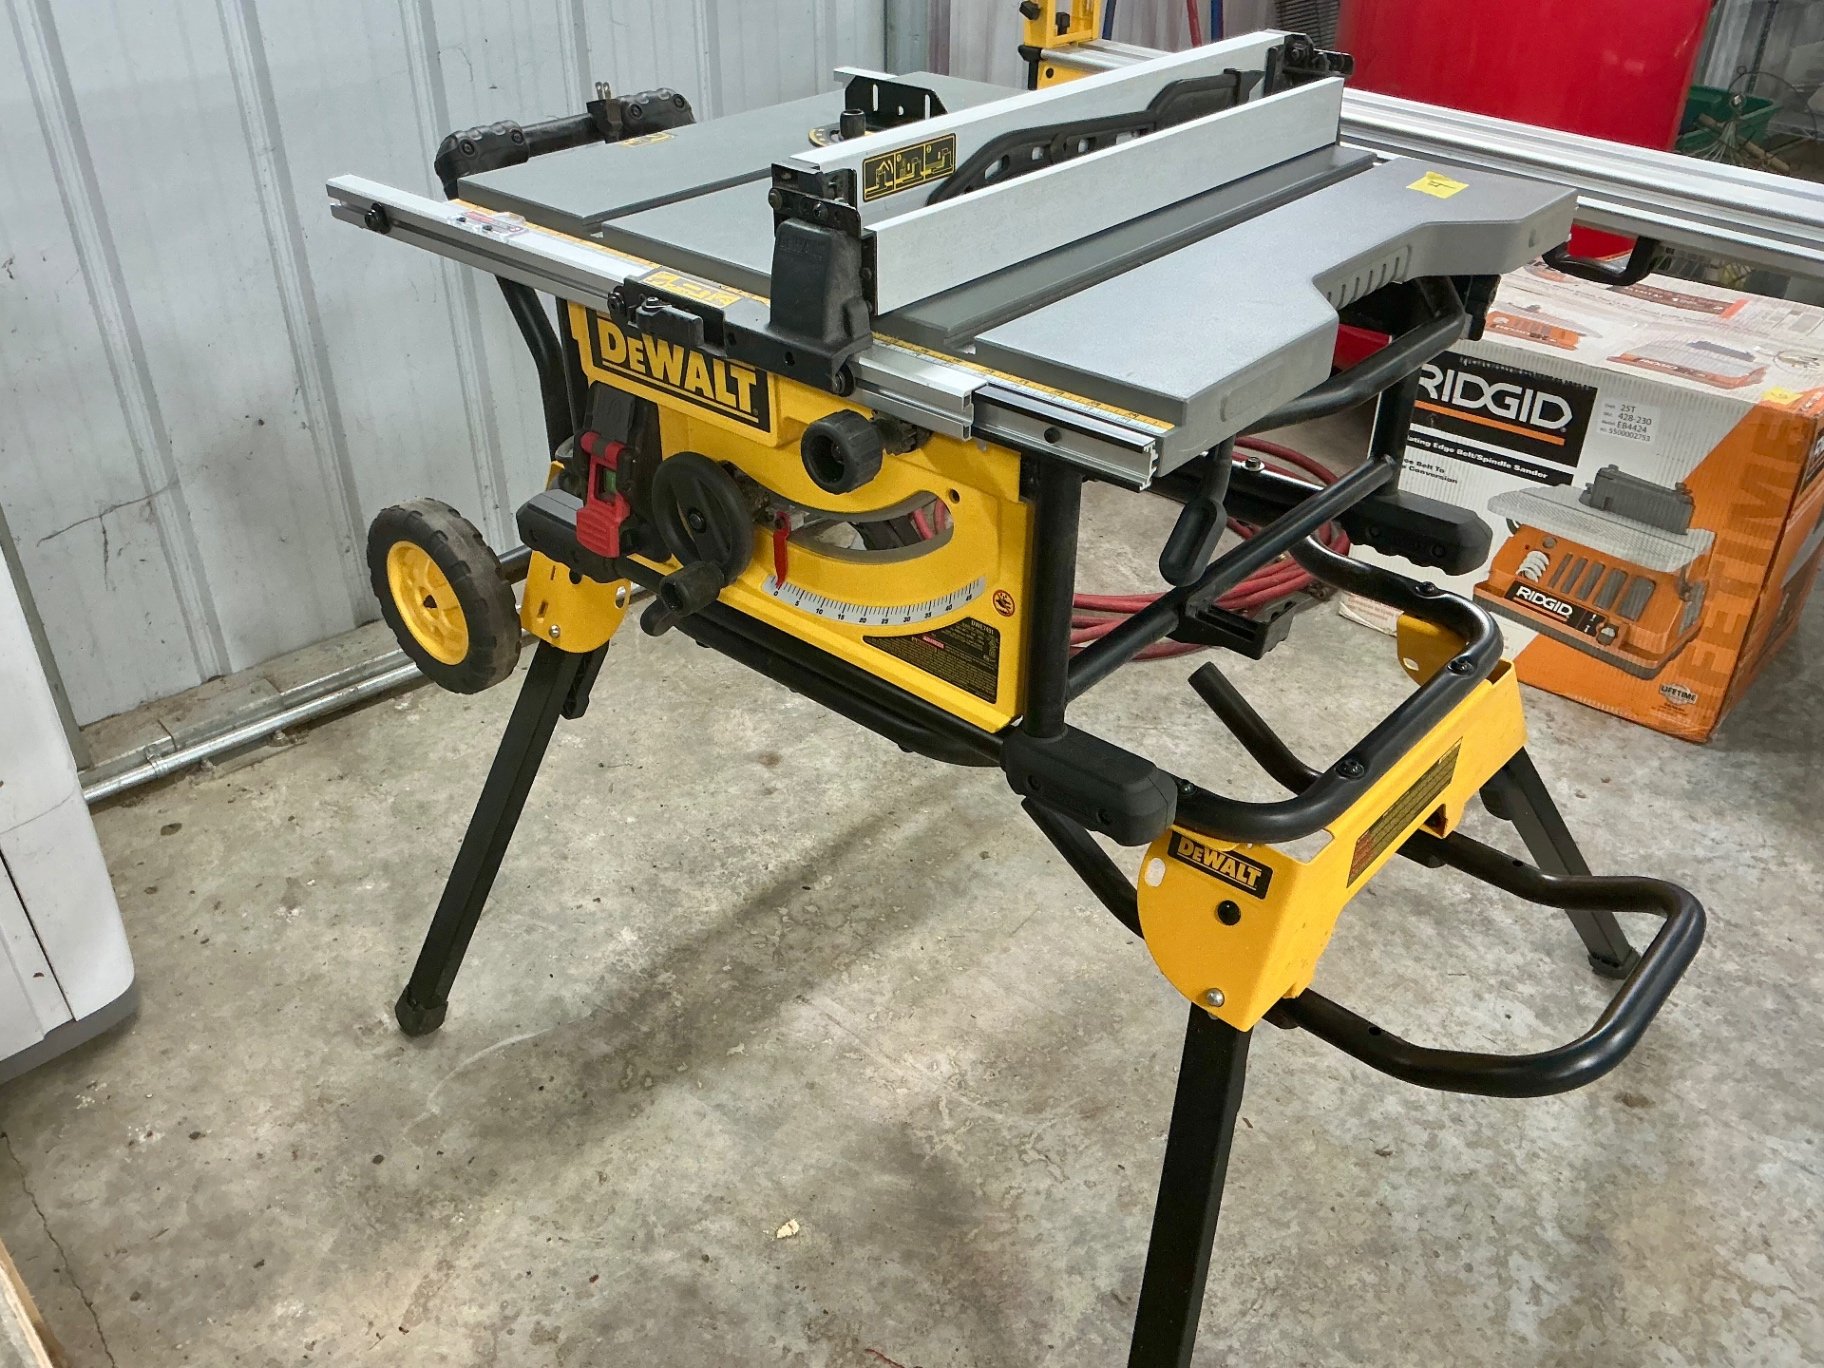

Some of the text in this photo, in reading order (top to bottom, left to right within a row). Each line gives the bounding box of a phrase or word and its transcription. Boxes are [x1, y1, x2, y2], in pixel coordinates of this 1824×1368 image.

[1419, 363, 1573, 431] RIDGID
[1618, 413, 1652, 426] 428-230
[1433, 442, 1455, 453] Edge
[1456, 448, 1512, 469] Belt/Spindle
[1513, 464, 1549, 479] Sander
[1409, 465, 1458, 484] Conversion
[1516, 585, 1573, 617] RIDGID
[838, 613, 845, 621] 15
[1661, 685, 1697, 702] LIFETIME
